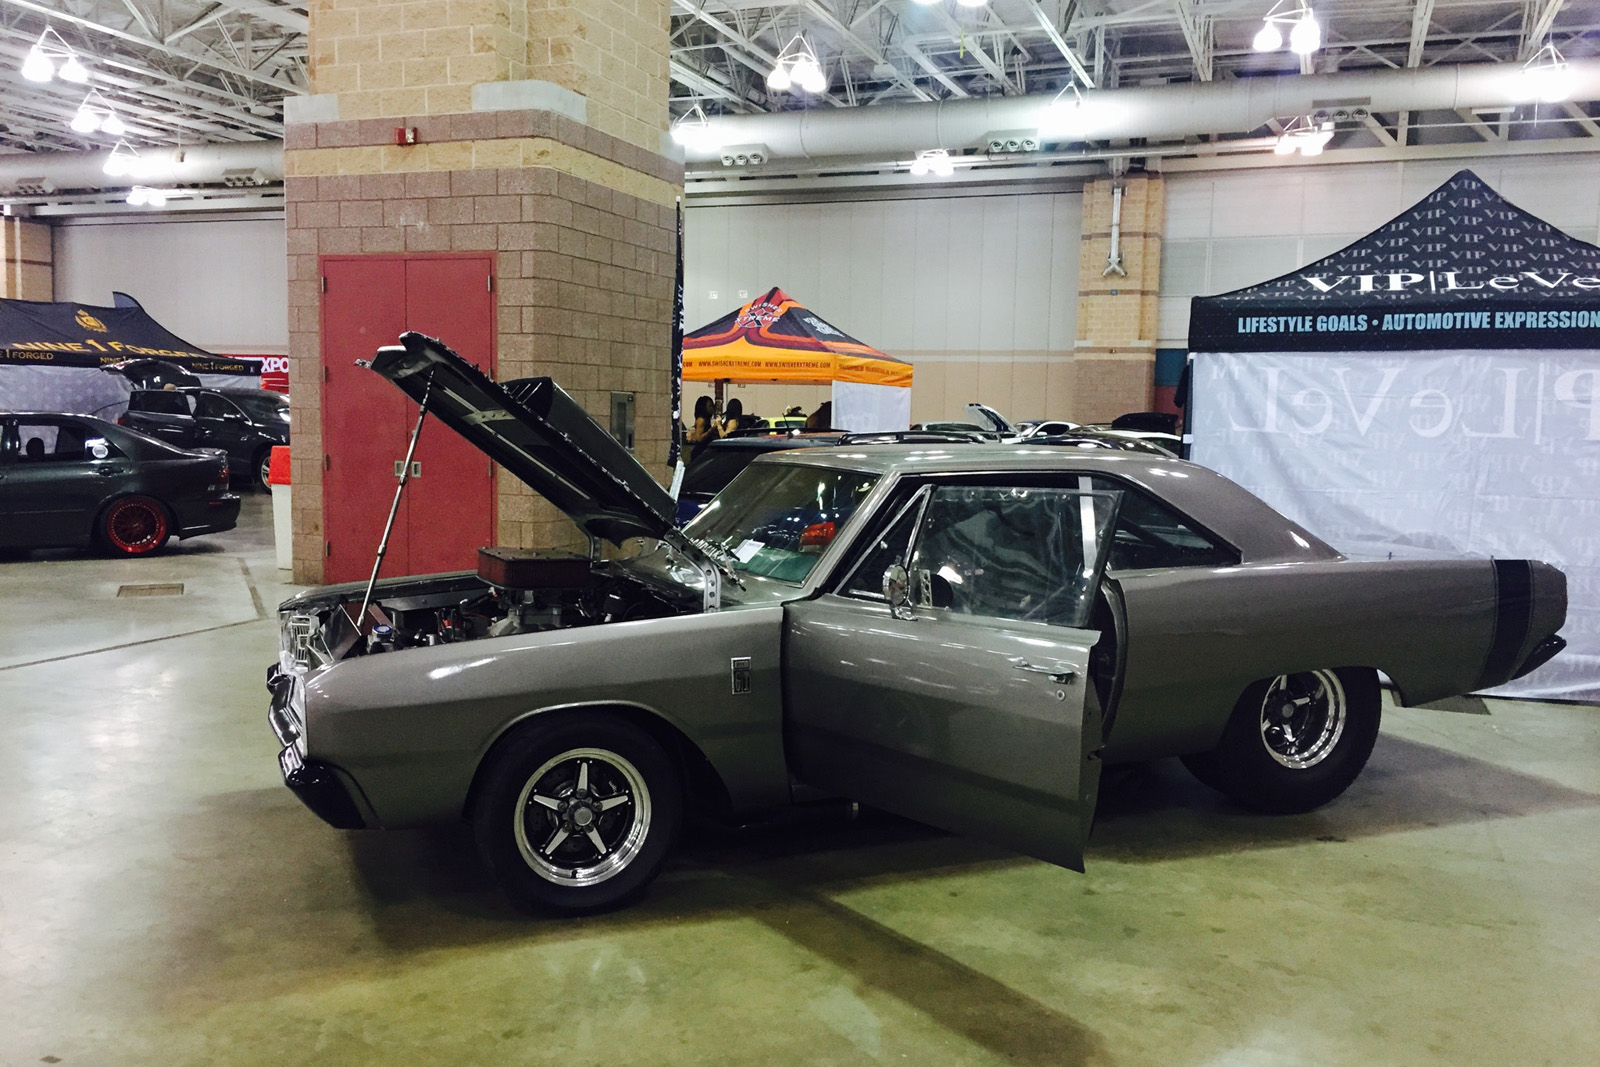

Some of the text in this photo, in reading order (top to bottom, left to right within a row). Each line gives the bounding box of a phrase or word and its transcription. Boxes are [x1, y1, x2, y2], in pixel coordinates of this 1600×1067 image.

[1450, 180, 1481, 190] VIP
[1448, 198, 1481, 208] VIP
[1412, 208, 1446, 220] VIP
[1484, 208, 1518, 220] VIP
[1448, 216, 1482, 226] VIP
[1411, 226, 1446, 236] VIP
[1486, 226, 1521, 236] VIP
[1448, 234, 1484, 242] VIP
[1524, 237, 1560, 246] VIP
[1375, 238, 1410, 248] VIP
[1411, 243, 1447, 252] VIP
[1488, 242, 1524, 252] VIP
[1340, 249, 1372, 258] VIP
[1374, 254, 1410, 262] VIP
[1450, 250, 1486, 259] VIP
[1528, 253, 1564, 261] VIP
[1412, 259, 1448, 268] VIP
[1490, 259, 1526, 267] VIP
[1238, 316, 1312, 333] LIFESTYLE
[1316, 314, 1368, 332] GOALS
[1382, 312, 1490, 330] AUTOMOTIVE
[12, 352, 54, 360] FORGED
